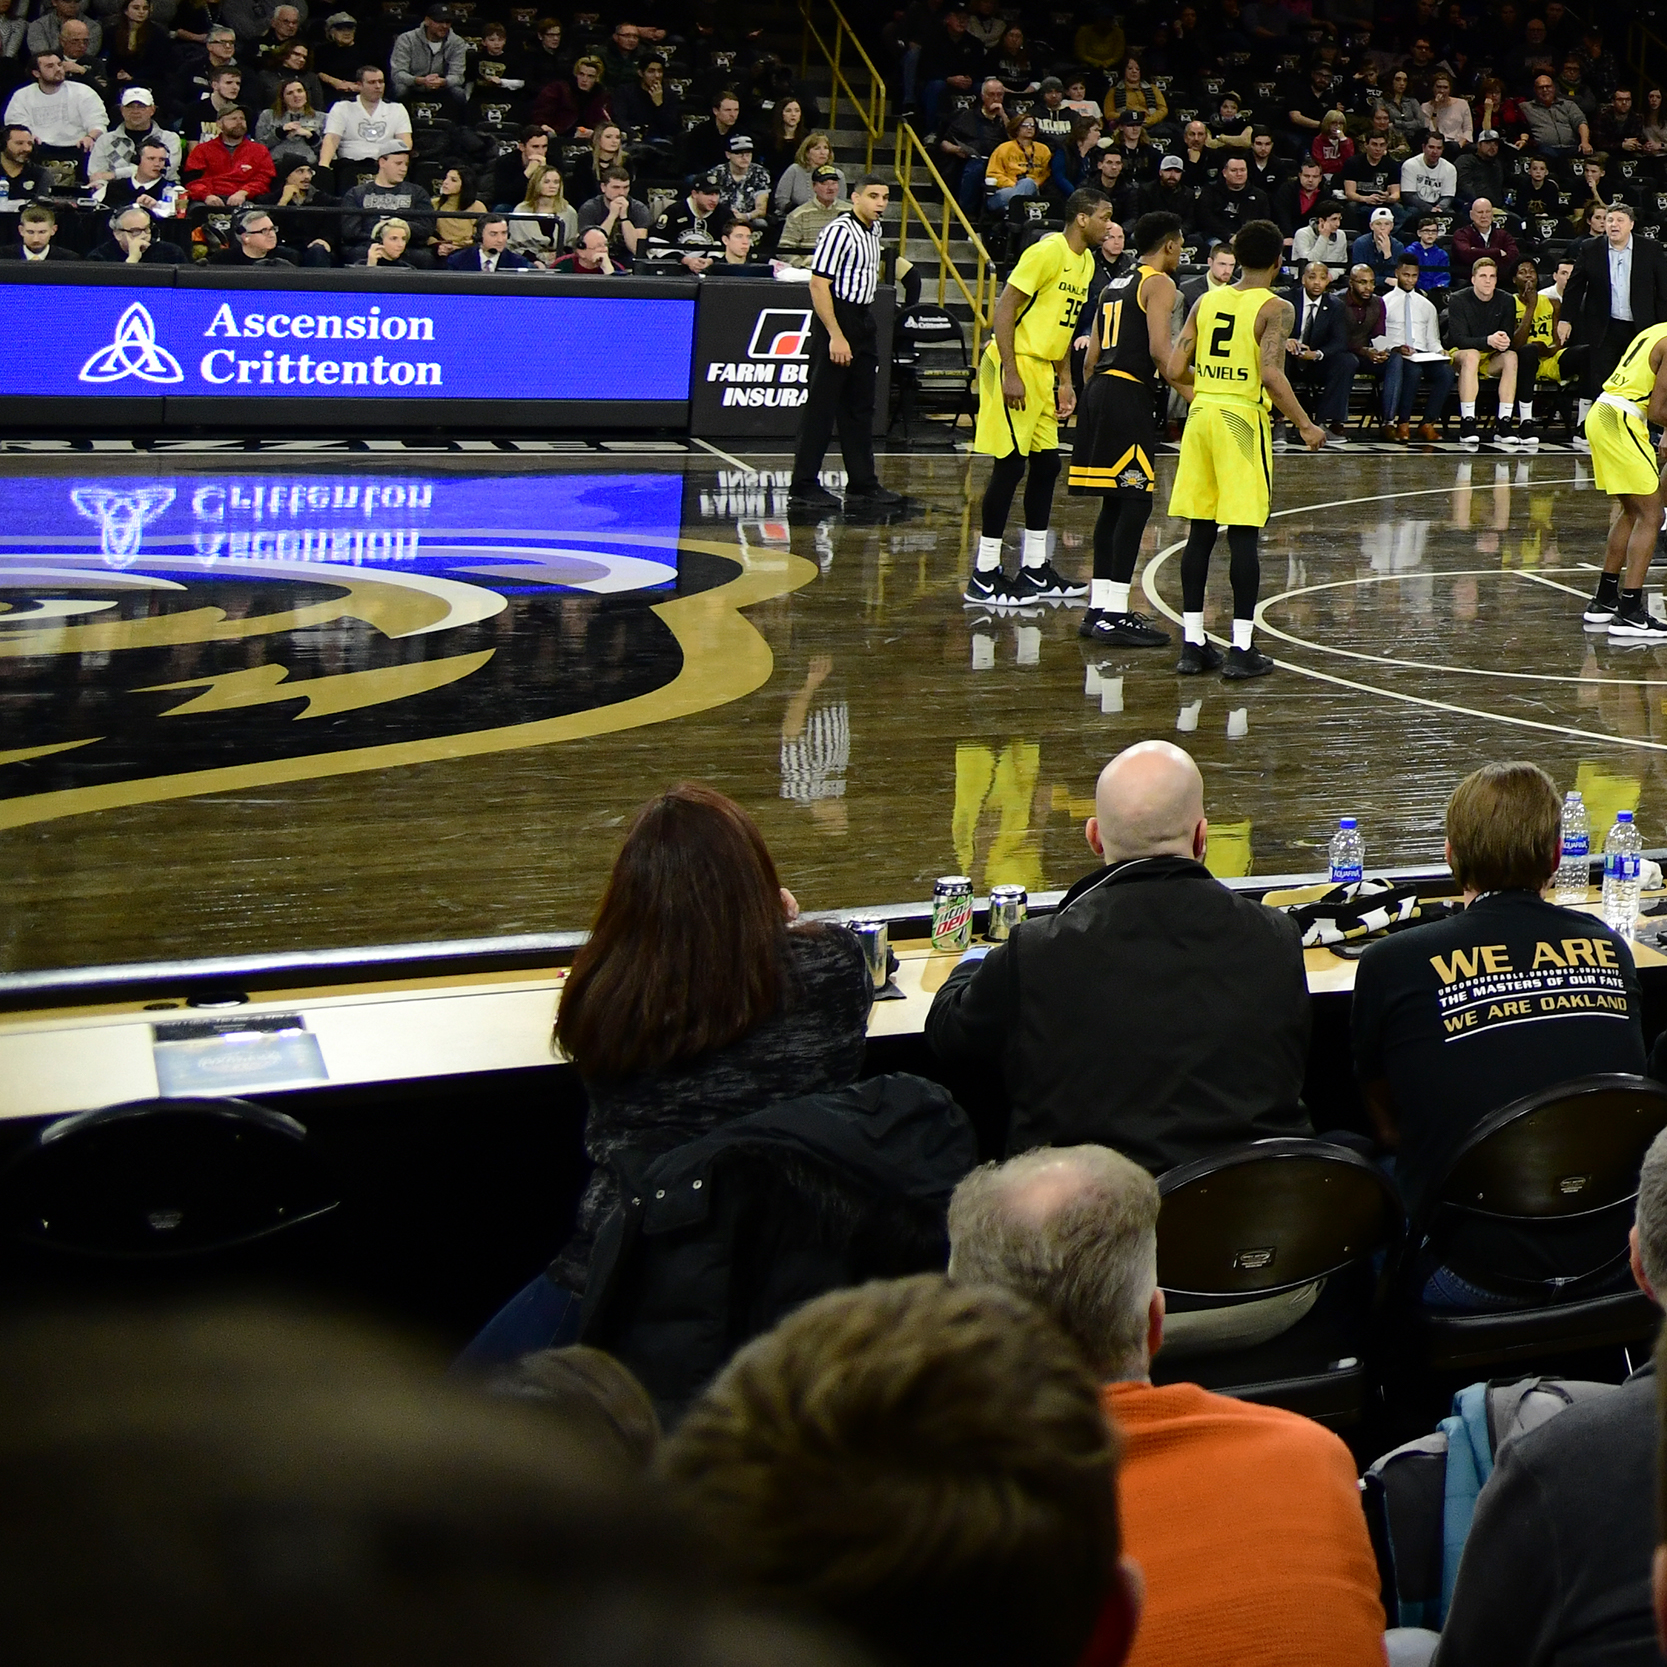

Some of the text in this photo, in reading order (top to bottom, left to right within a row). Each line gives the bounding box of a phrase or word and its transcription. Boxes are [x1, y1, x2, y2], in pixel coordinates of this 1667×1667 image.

[205, 303, 435, 340] Ascension
[1060, 297, 1084, 329] 35
[1101, 299, 1123, 350] 11
[1209, 312, 1235, 358] 2
[1622, 337, 1649, 368] 1
[200, 349, 443, 385] Crittenton
[706, 363, 775, 383] FARM
[1430, 938, 1620, 984] WE ARE
[1439, 975, 1624, 1008] THE MASTERS OF OUR FATE
[1443, 994, 1628, 1033] WE ARE OAKLAND
